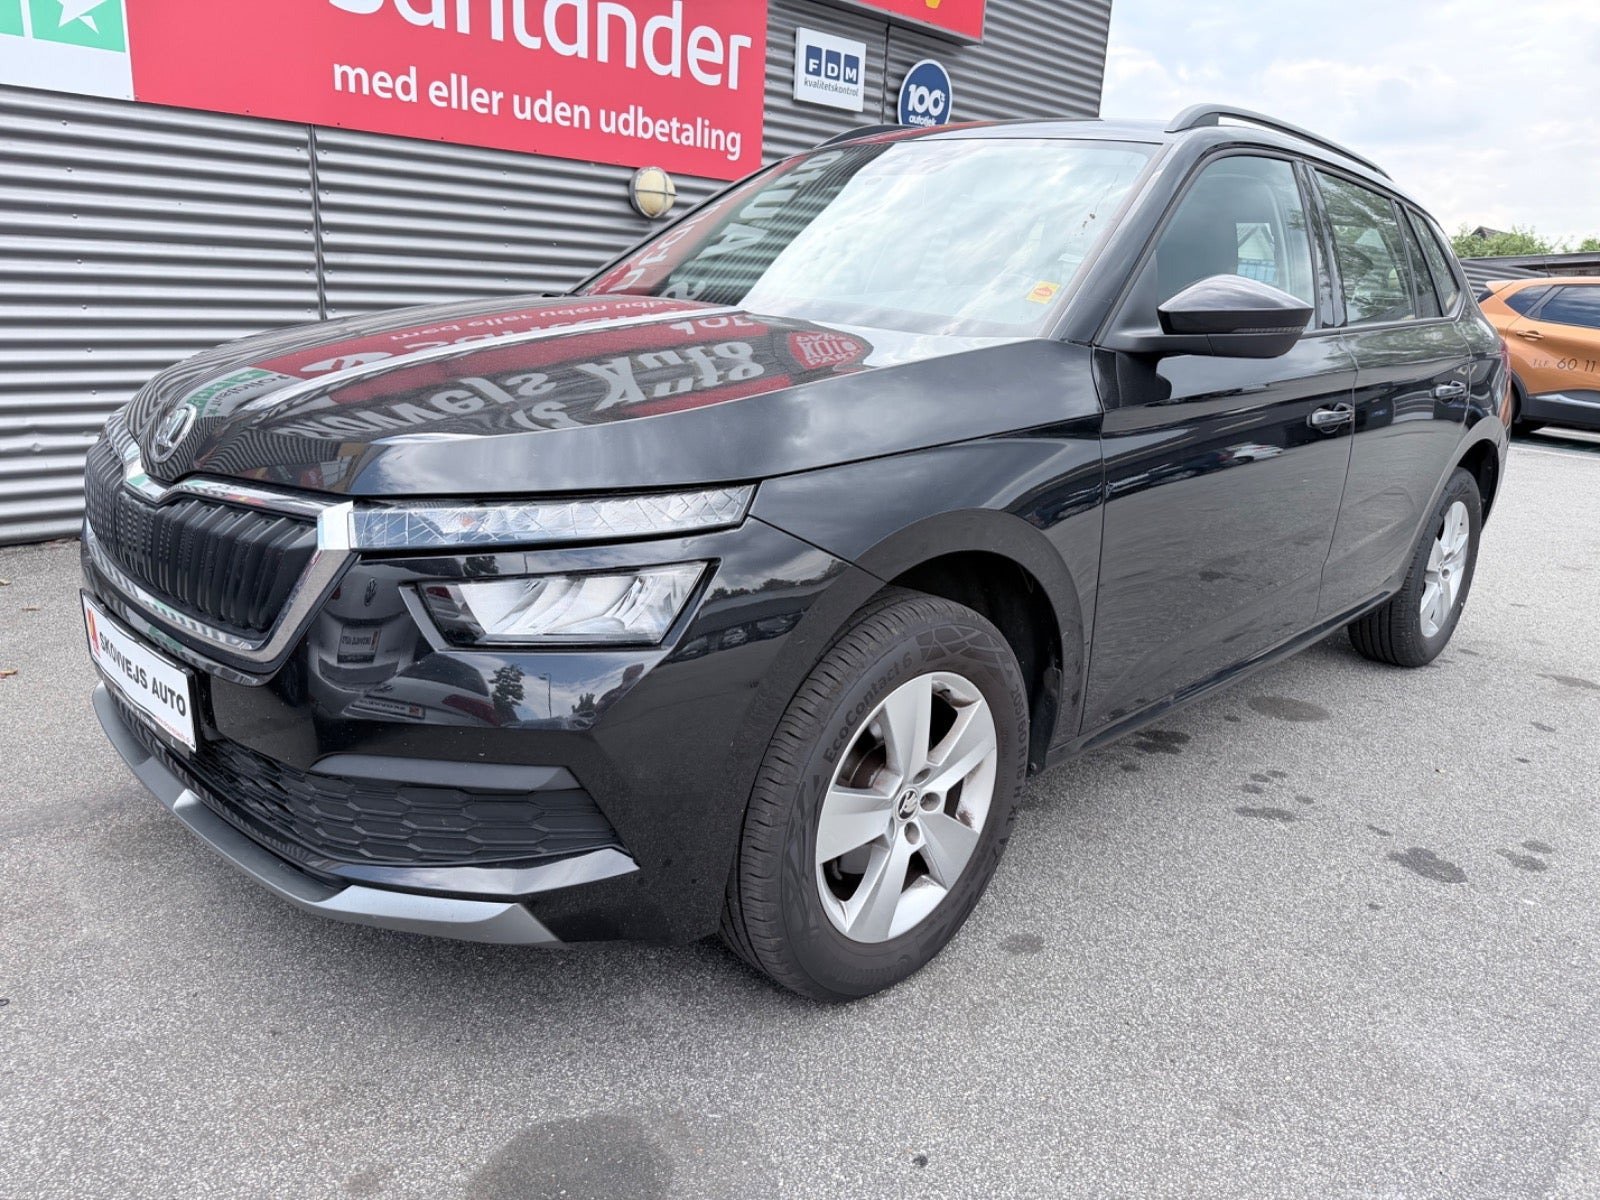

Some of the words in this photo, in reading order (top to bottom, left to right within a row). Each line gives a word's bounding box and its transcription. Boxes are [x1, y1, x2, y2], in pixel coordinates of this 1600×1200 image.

[328, 0, 752, 90] ntander
[807, 57, 858, 82] FDM
[333, 63, 417, 103] med
[428, 73, 503, 116] eller
[513, 90, 590, 130] uden
[600, 104, 741, 161] udbetaling
[803, 77, 859, 97] kvalitetskontrol
[1556, 357, 1578, 371] 60
[99, 631, 149, 690] SKOVVEJS
[151, 676, 187, 717] AUTO
[822, 667, 902, 764] EcoContact
[902, 651, 914, 668] 6
[1010, 683, 1027, 743] 205/60
